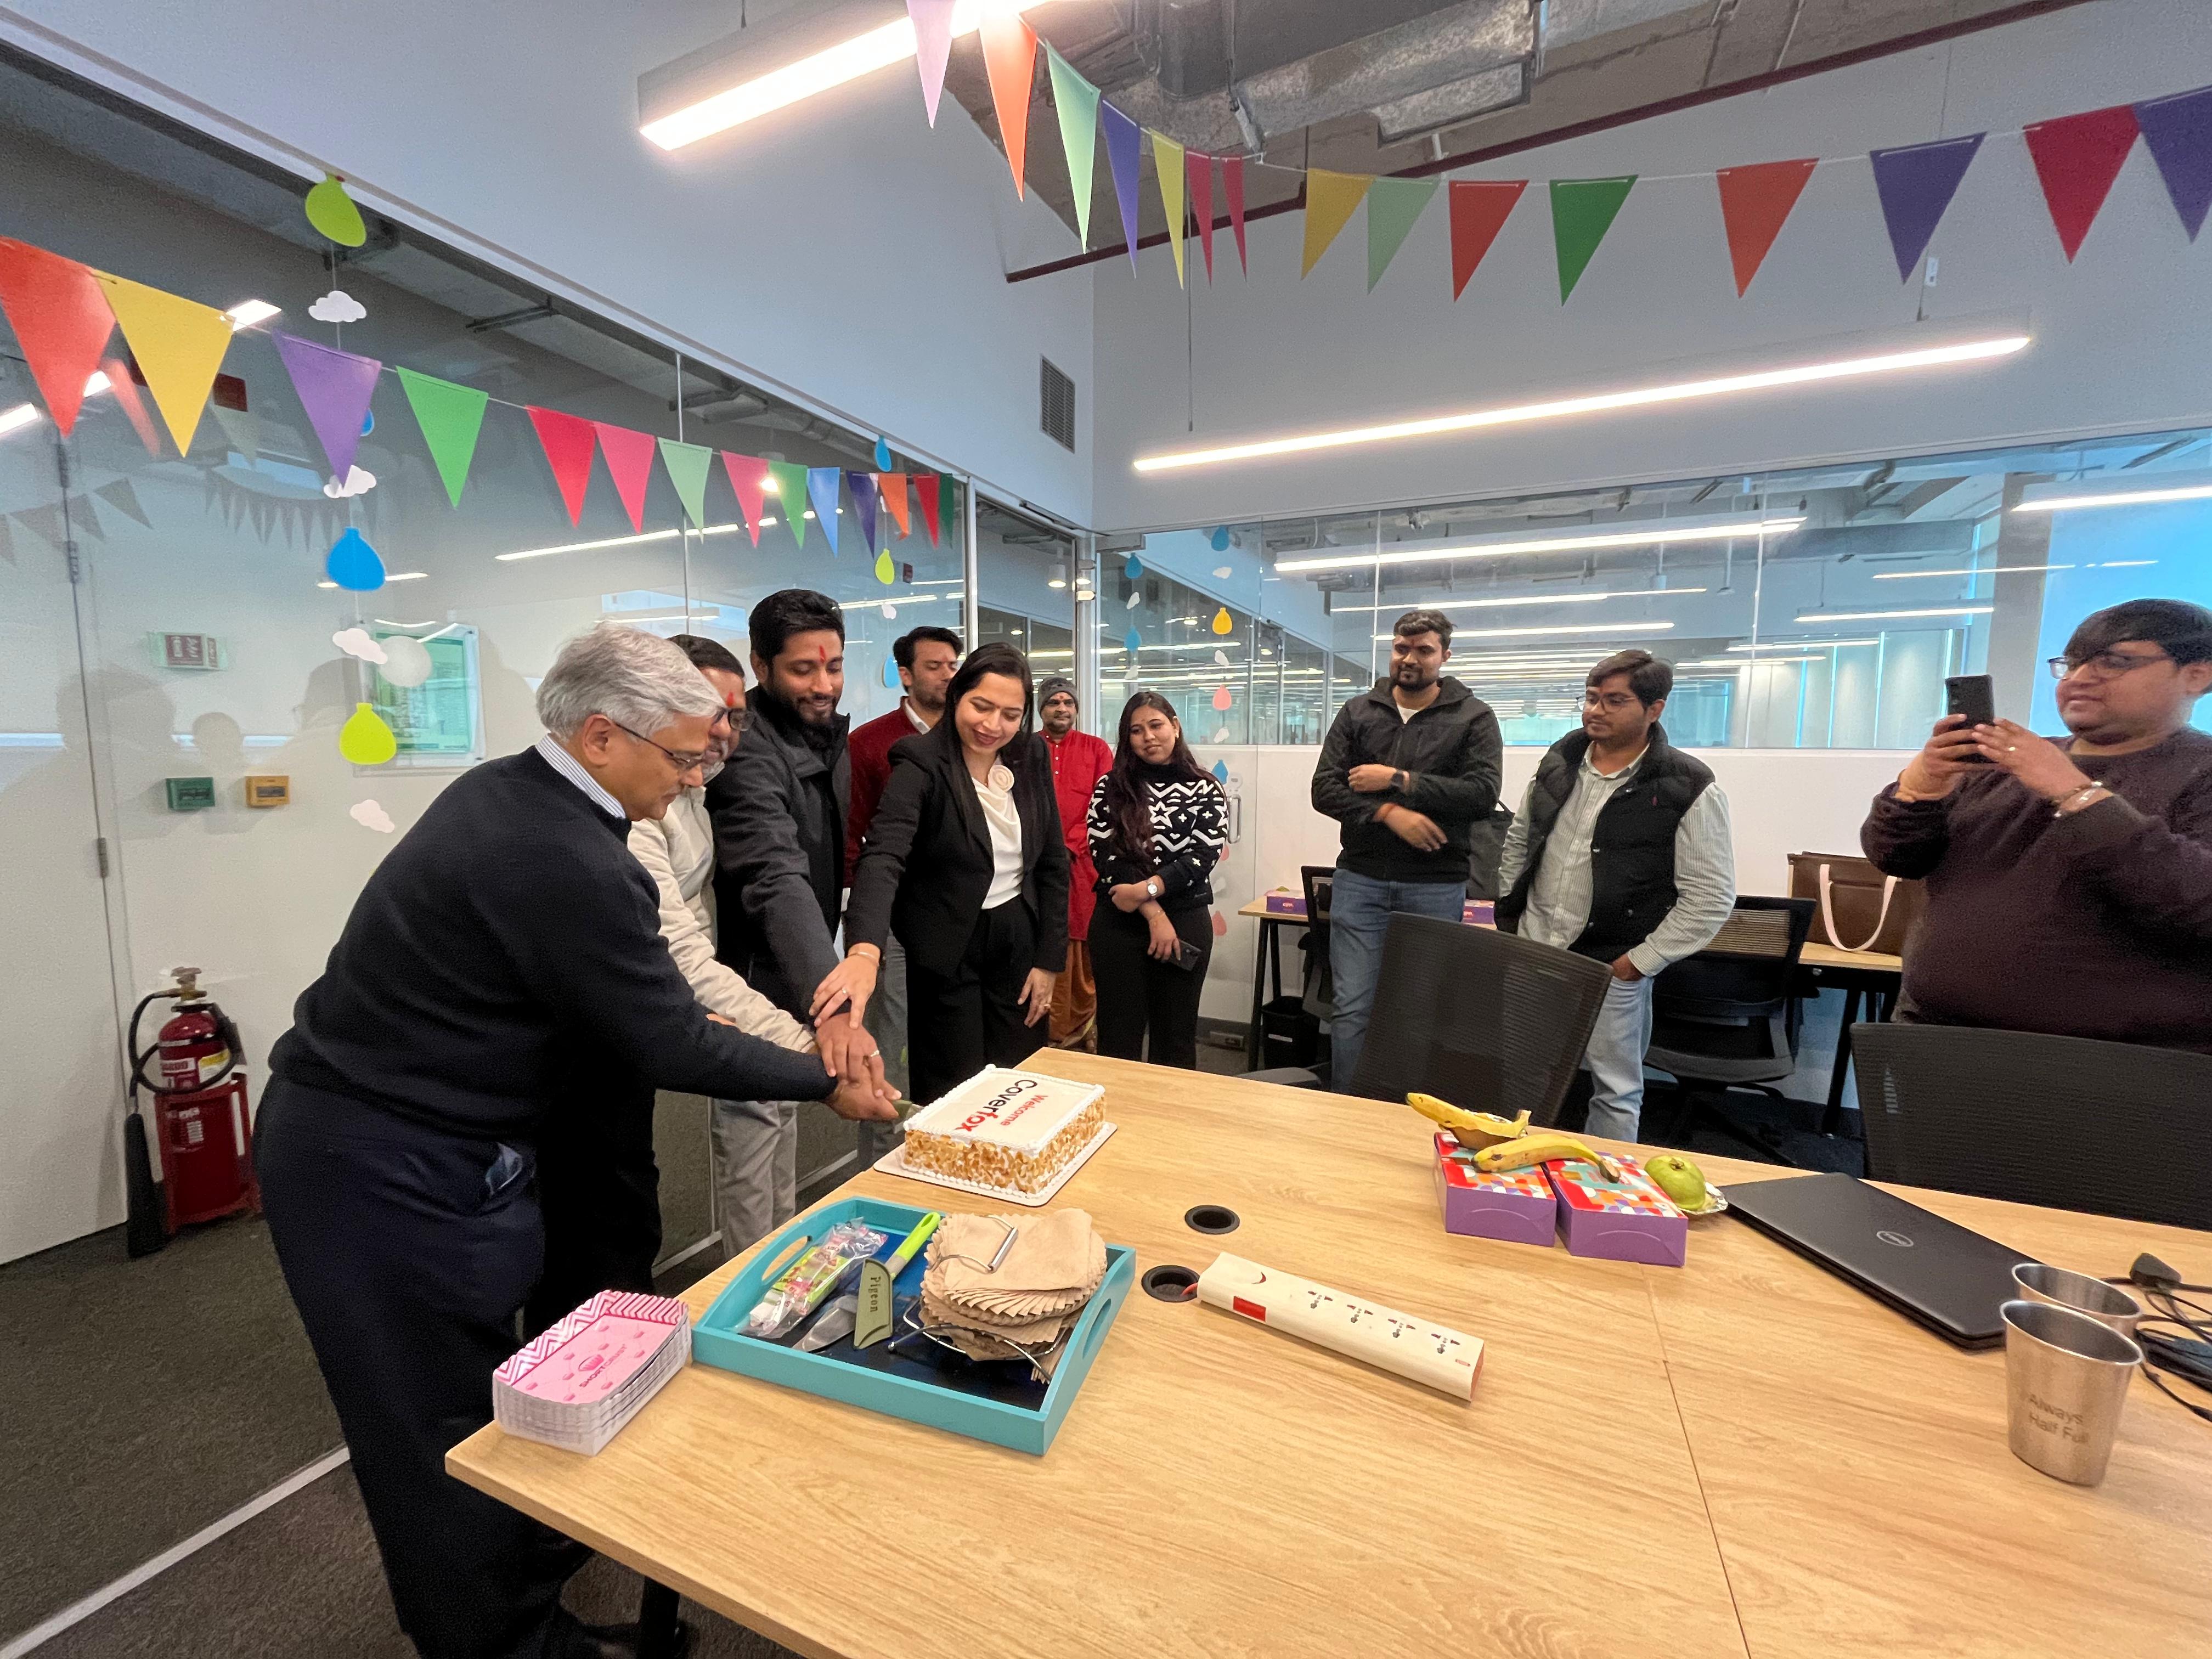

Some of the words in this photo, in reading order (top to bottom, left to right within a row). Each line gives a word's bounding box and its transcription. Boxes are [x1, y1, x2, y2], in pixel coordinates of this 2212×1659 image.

[955, 1079, 1038, 1132] Coverfox
[1000, 1094, 1048, 1126] Welcome
[868, 1276, 881, 1312] Pigeon
[2029, 1393, 2084, 1425] Always
